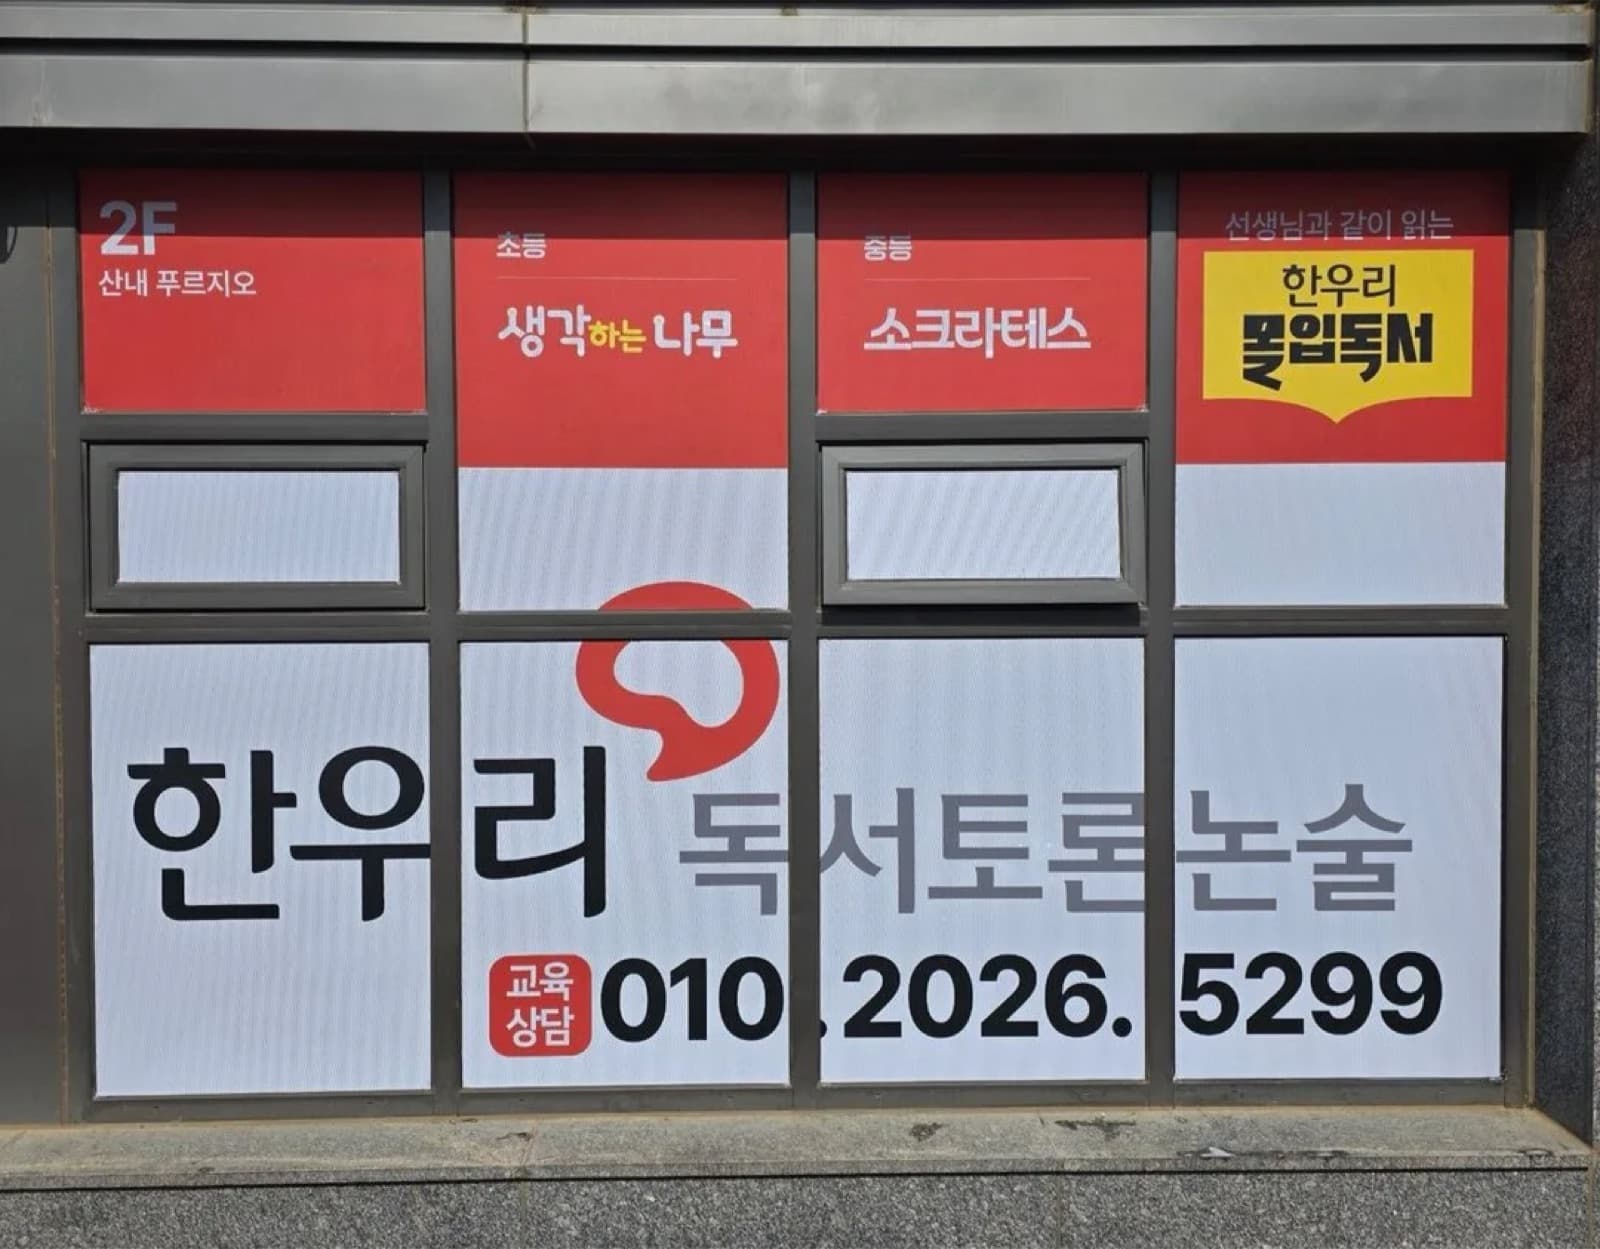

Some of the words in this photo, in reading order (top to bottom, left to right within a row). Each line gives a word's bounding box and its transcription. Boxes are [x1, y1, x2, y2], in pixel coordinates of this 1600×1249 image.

[100, 201, 177, 256] 2F
[496, 231, 547, 261] 초등
[1225, 210, 1333, 242] 선생님과
[1340, 210, 1393, 241] 같이
[1400, 209, 1455, 241] 읽는
[863, 234, 912, 262] 중등
[98, 269, 149, 297] 산내
[156, 270, 257, 298] 푸르지오
[1282, 264, 1396, 308] 한우리
[498, 304, 647, 358] 생각하는
[653, 309, 739, 358] 나무
[863, 306, 1092, 358] 소크라테스
[1242, 312, 1433, 391] 몰입독서
[127, 745, 606, 922] 한우리
[679, 783, 1413, 914] 독서토론논술
[506, 961, 574, 1003] 교육
[506, 1005, 575, 1048] 상담
